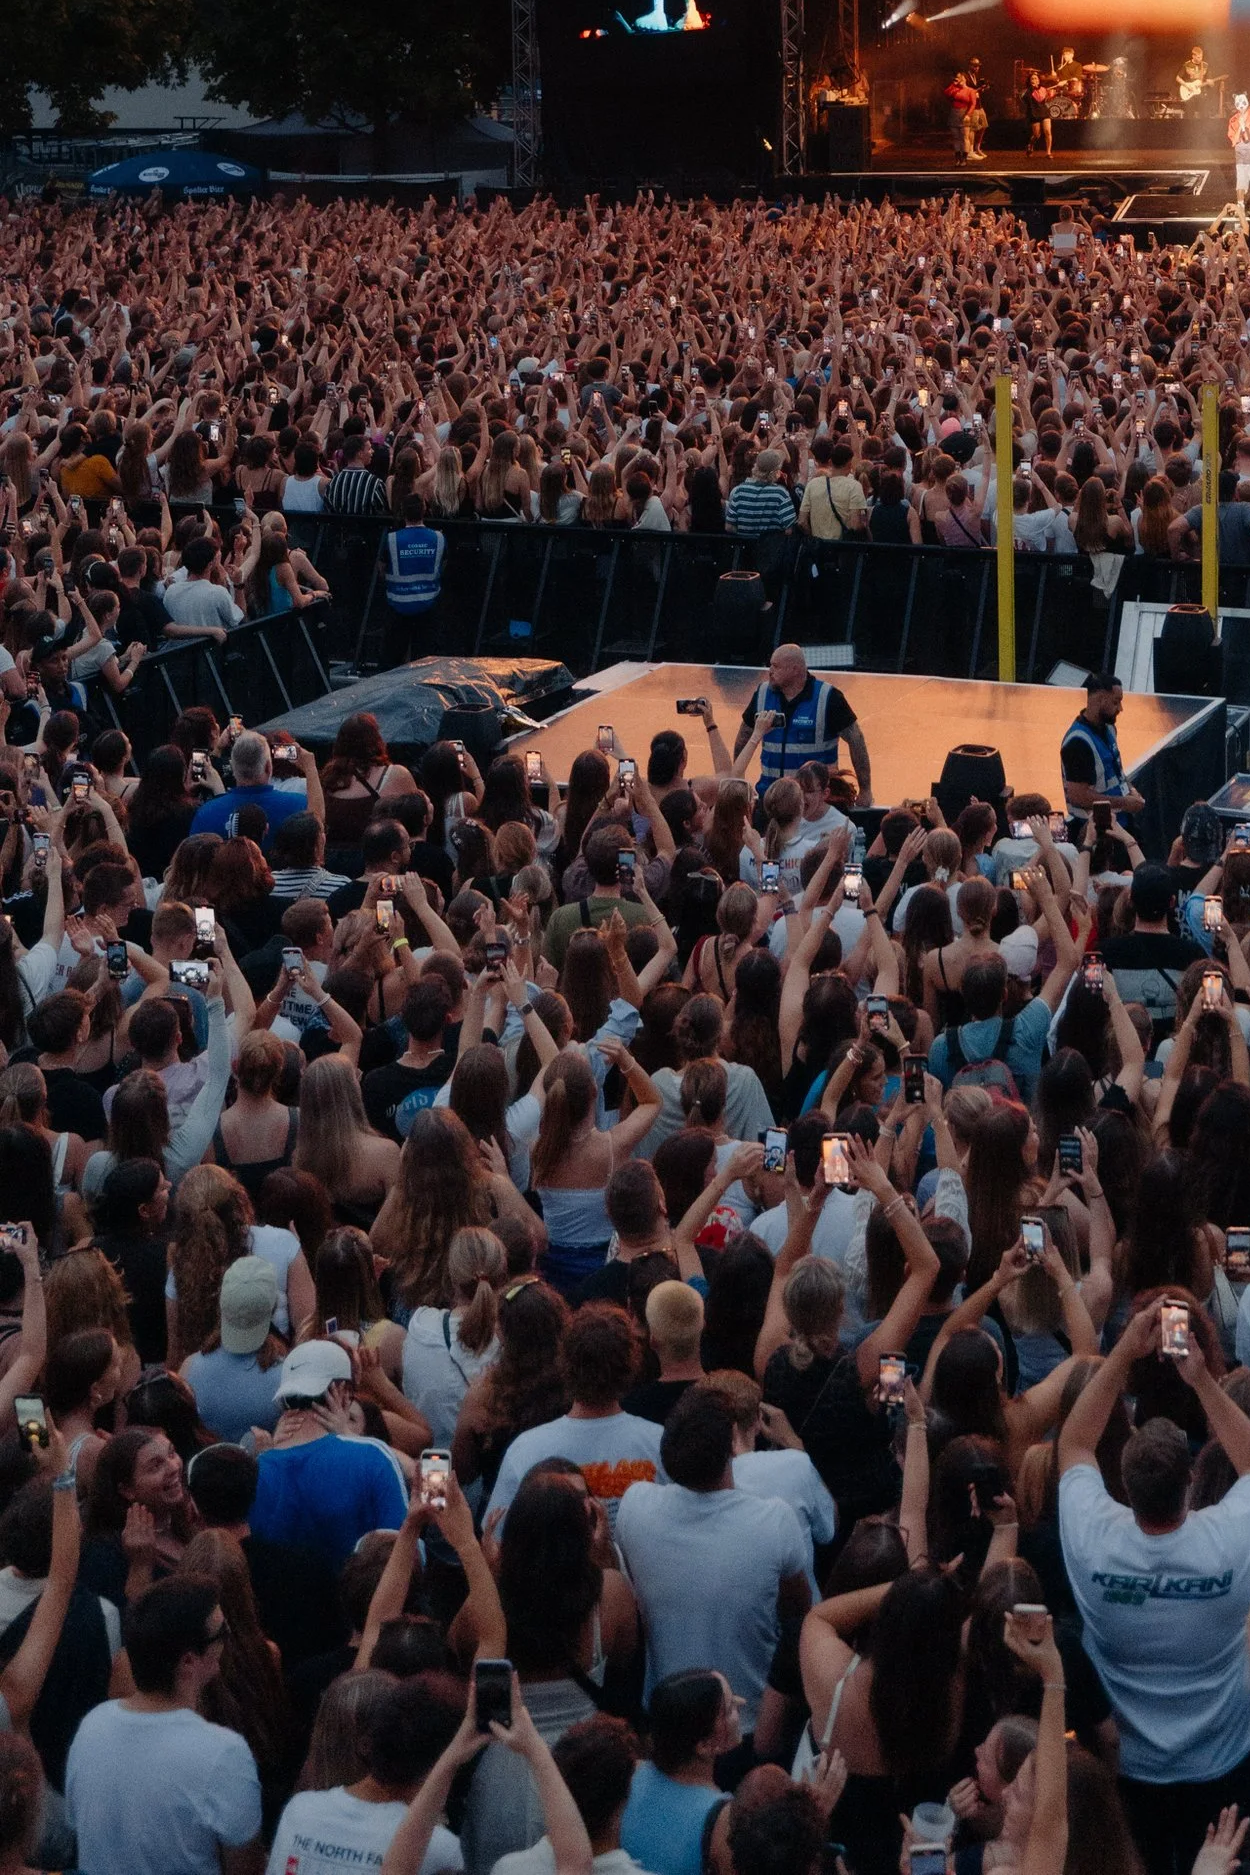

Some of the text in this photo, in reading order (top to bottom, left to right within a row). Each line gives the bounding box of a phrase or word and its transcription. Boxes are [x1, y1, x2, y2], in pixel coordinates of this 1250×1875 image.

[400, 548, 436, 557] SECURITY
[293, 1834, 383, 1867] THE NORTH FA
